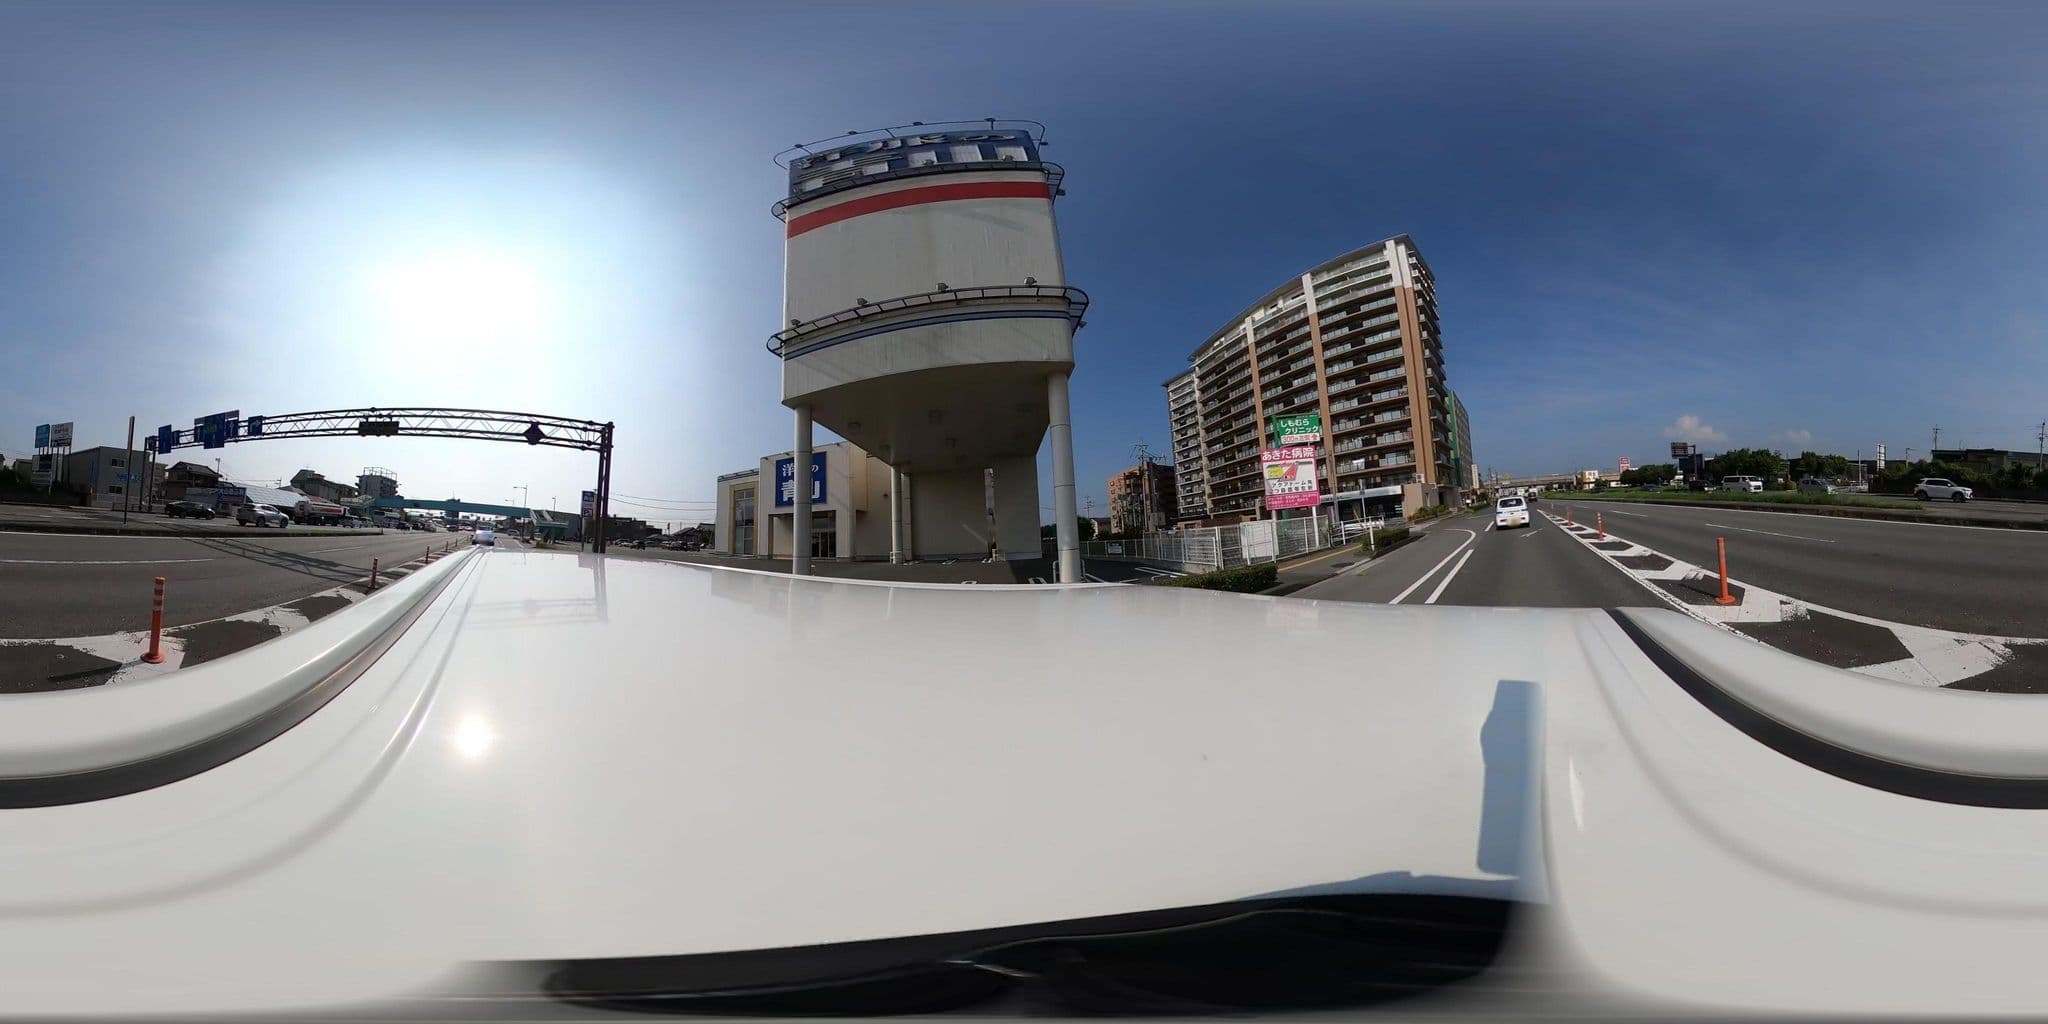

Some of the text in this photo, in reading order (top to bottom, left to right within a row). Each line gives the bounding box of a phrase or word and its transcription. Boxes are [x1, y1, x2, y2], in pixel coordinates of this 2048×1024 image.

[1280, 418, 1310, 428] しもむら
[1284, 426, 1319, 435] クリニック
[1262, 447, 1315, 461] あきた病院
